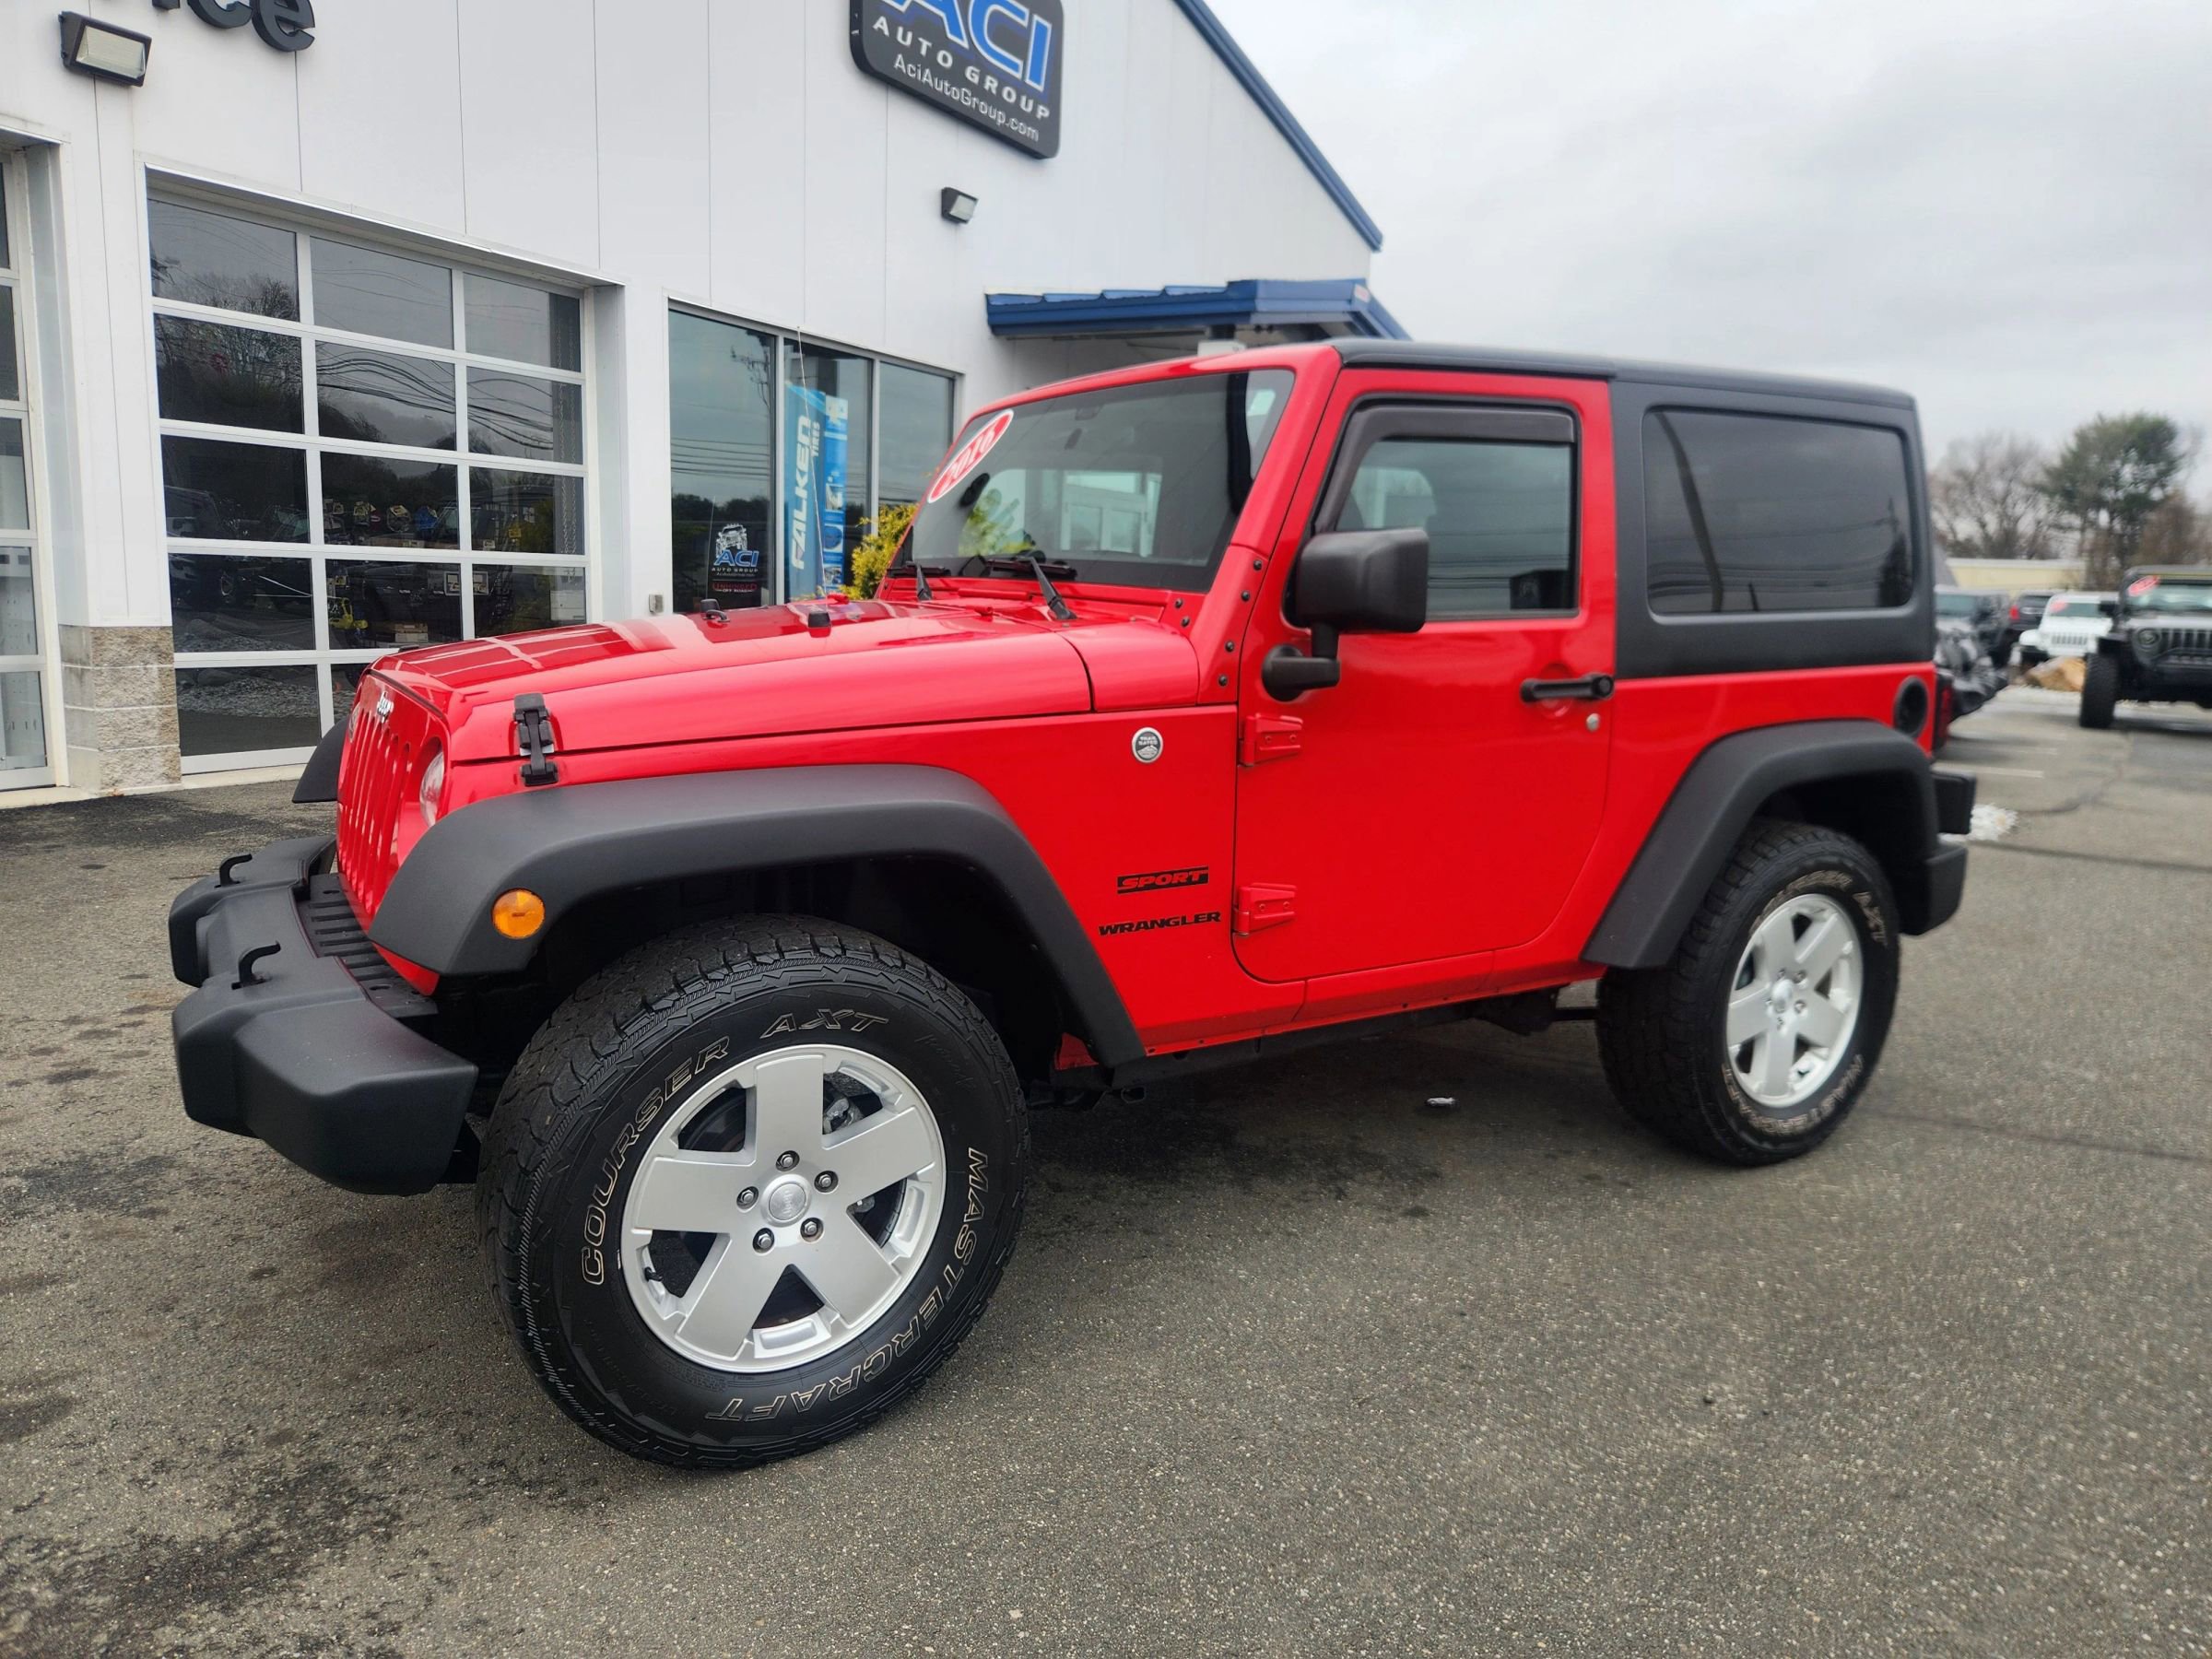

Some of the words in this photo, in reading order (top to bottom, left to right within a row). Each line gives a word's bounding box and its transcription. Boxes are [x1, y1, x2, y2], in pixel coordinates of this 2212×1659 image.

[872, 15, 953, 69] AUTO
[964, 65, 1051, 121] GROUP
[877, 0, 1053, 92] ACI
[893, 53, 1041, 142] AciAutoGroup.com
[792, 415, 812, 570] FALKEN
[713, 549, 759, 567] ACI
[1099, 911, 1221, 936] WRANGLER
[1118, 869, 1208, 889] SPORT
[581, 1036, 730, 1286] COURSER
[759, 1008, 889, 1040] AXT
[704, 1147, 989, 1422] MASTERCRAFT
